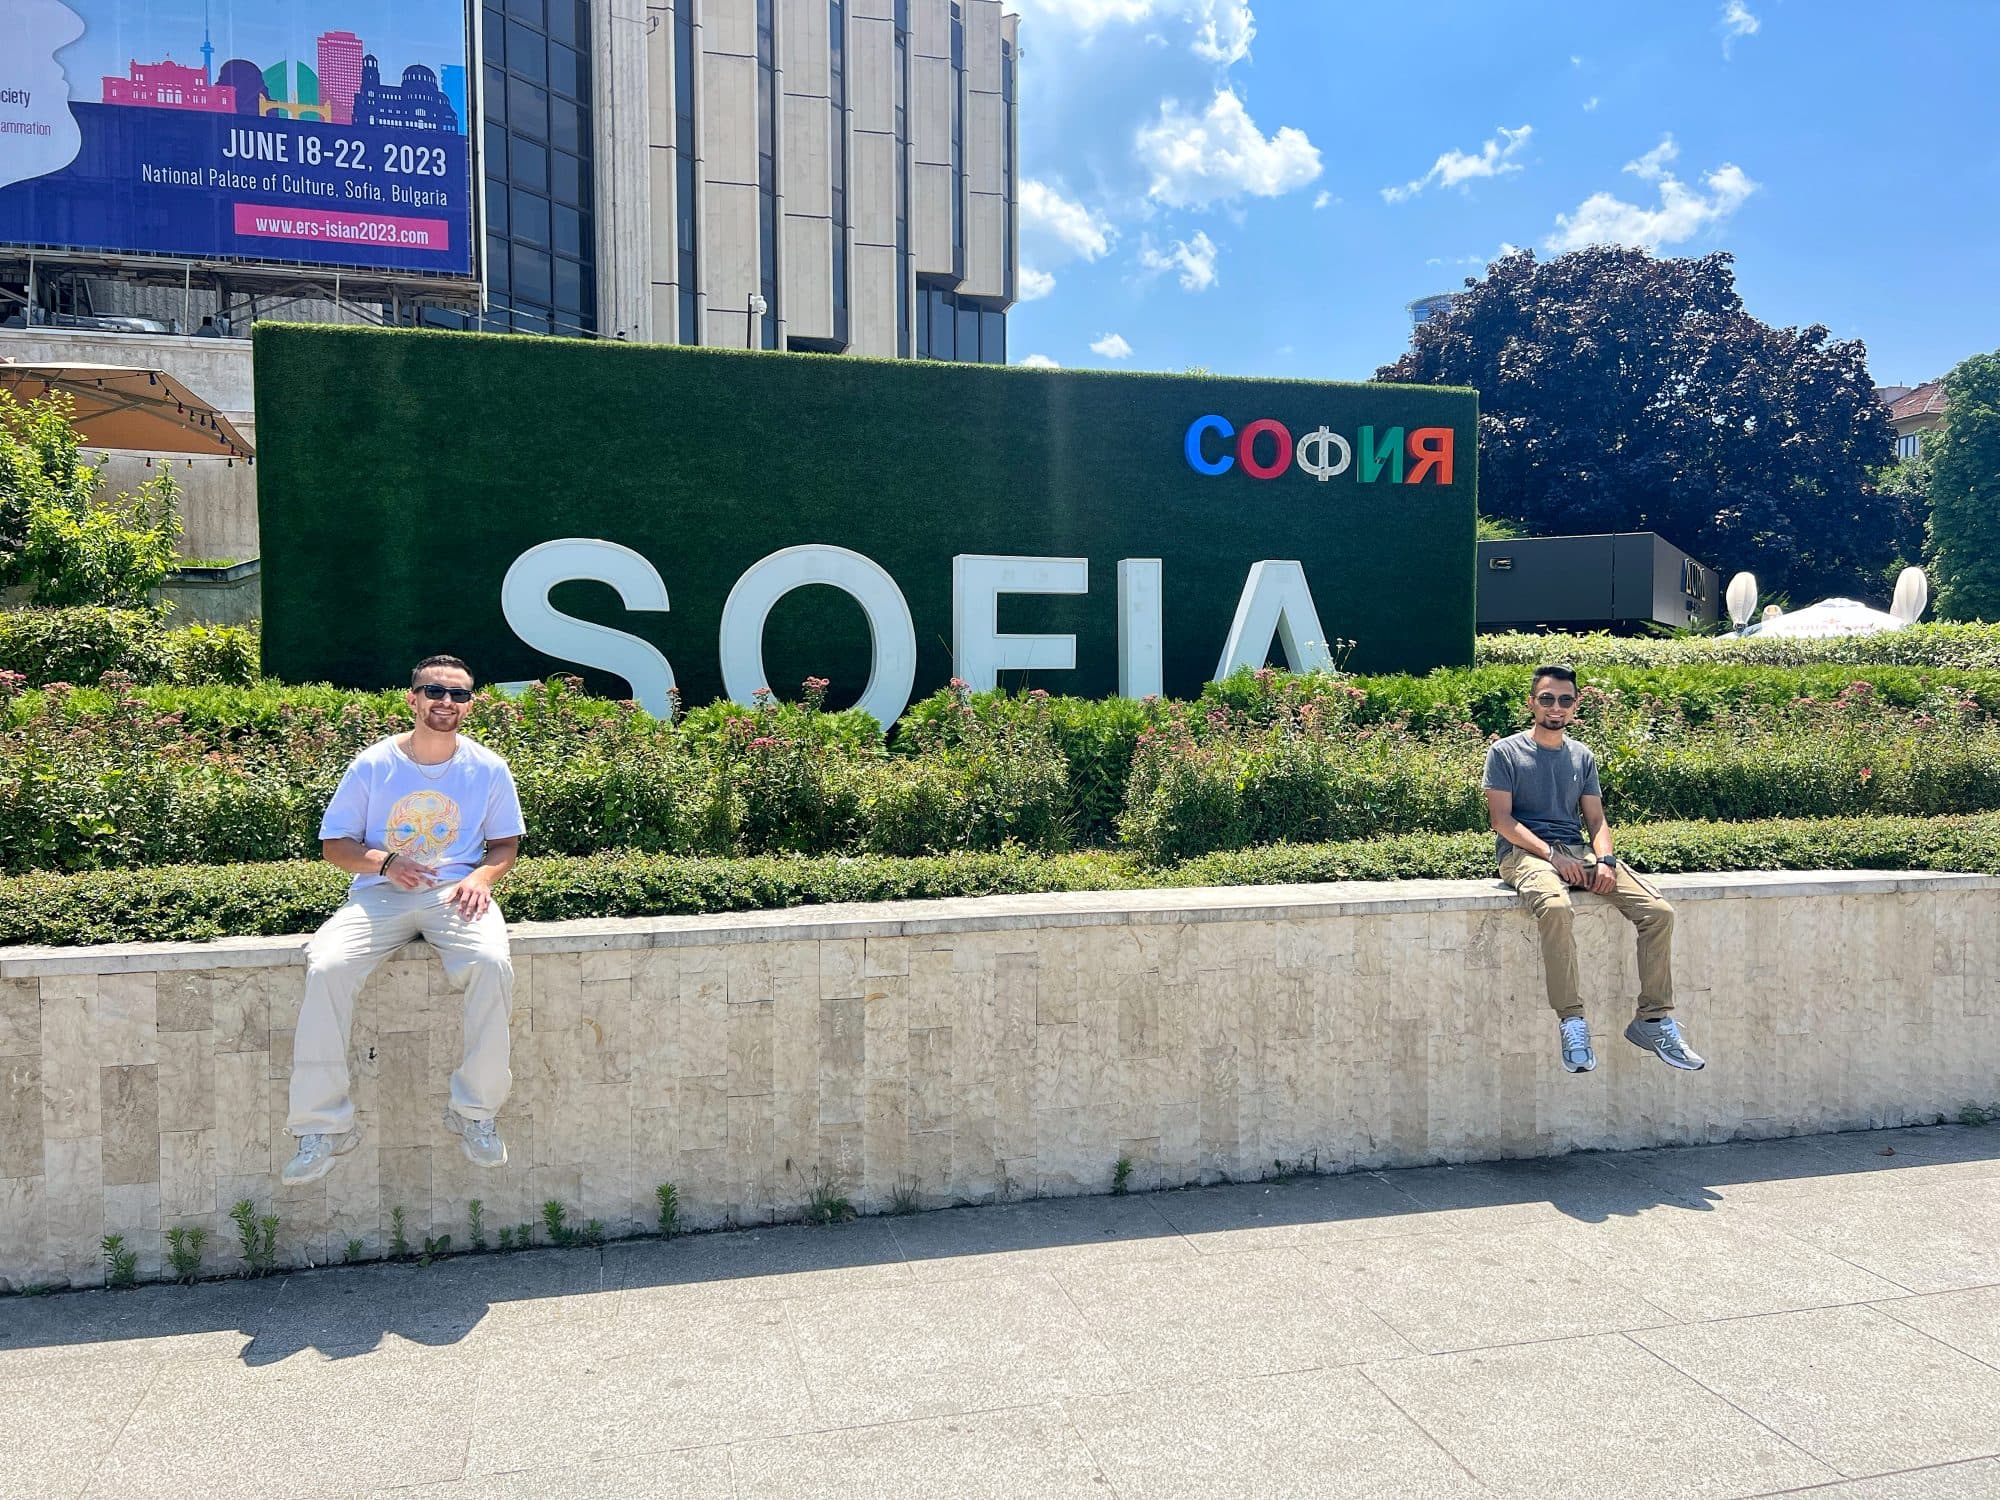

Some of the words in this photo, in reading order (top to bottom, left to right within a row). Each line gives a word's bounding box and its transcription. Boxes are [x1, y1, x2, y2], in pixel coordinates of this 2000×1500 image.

[0, 88, 30, 108] ciety
[0, 121, 51, 136] ammation
[222, 128, 289, 163] JUNE
[298, 135, 373, 172] 18-22,
[383, 143, 447, 177] 2023
[142, 163, 203, 186] National
[209, 168, 257, 190] Palace
[262, 174, 277, 192] of
[282, 174, 339, 198] Culture,
[345, 180, 386, 202] Sofia,
[392, 184, 448, 208] Bulgaria
[255, 215, 429, 245] www.ers-isian2023.com
[1184, 414, 1455, 485] СОФИЯ
[495, 537, 1336, 732] SOFIA
